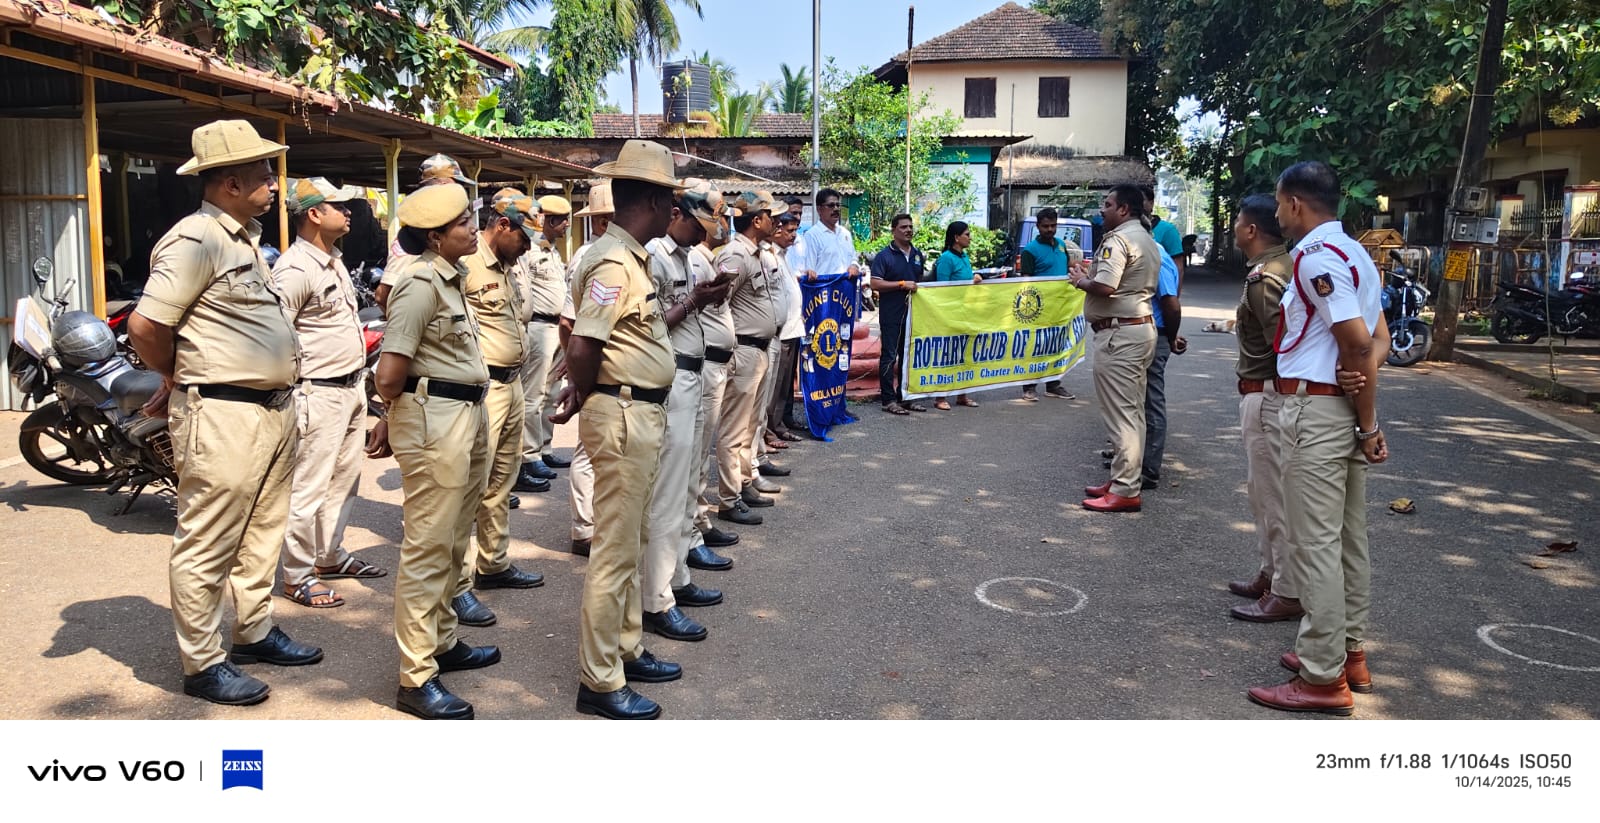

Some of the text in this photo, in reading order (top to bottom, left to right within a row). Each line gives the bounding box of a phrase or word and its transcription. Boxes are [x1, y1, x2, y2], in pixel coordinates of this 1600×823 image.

[832, 290, 853, 317] CLUB
[912, 334, 969, 369] ROTARY
[972, 331, 1008, 363] CLUB
[1011, 329, 1030, 359] OF
[957, 370, 974, 382] 3170
[980, 367, 1010, 378] Charter
[1014, 364, 1026, 375] No.
